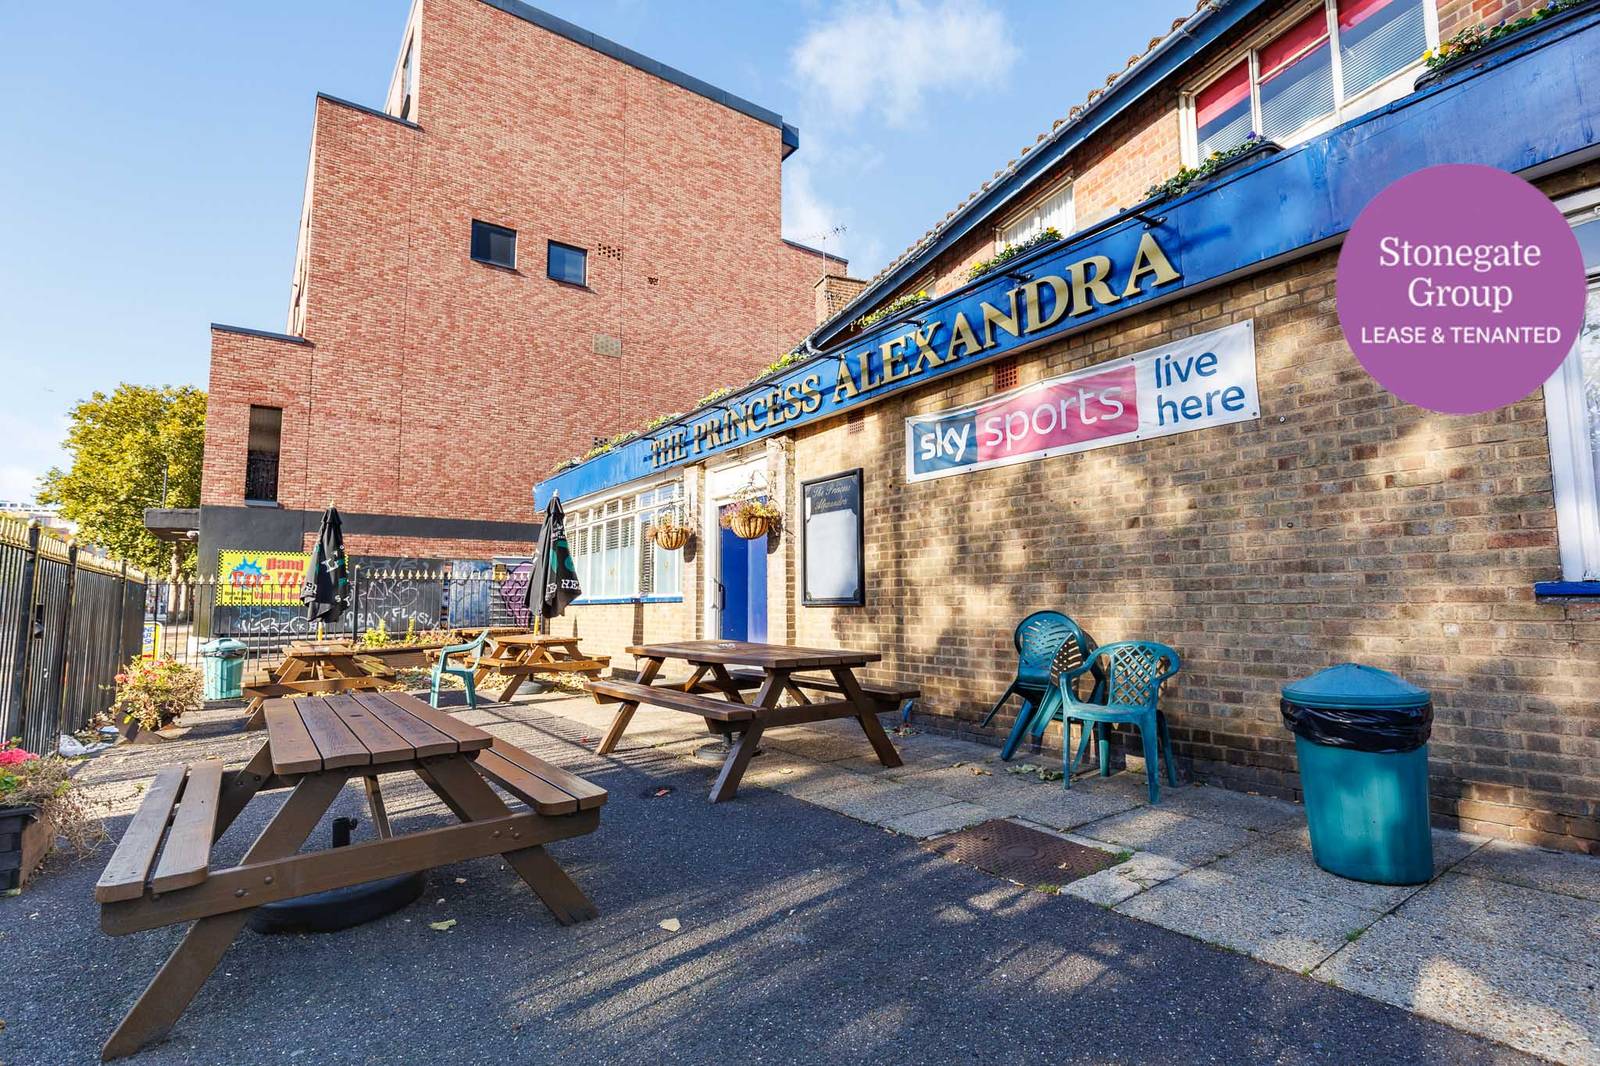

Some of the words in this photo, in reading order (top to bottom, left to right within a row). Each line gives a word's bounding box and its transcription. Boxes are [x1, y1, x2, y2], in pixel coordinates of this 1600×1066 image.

[650, 431, 688, 468] THE
[693, 374, 822, 454] PRINCESS
[831, 232, 1181, 403] ALEXANDRA
[1154, 351, 1218, 389] live
[920, 422, 971, 462] sky
[985, 386, 1125, 450] sports
[1156, 386, 1247, 427] here
